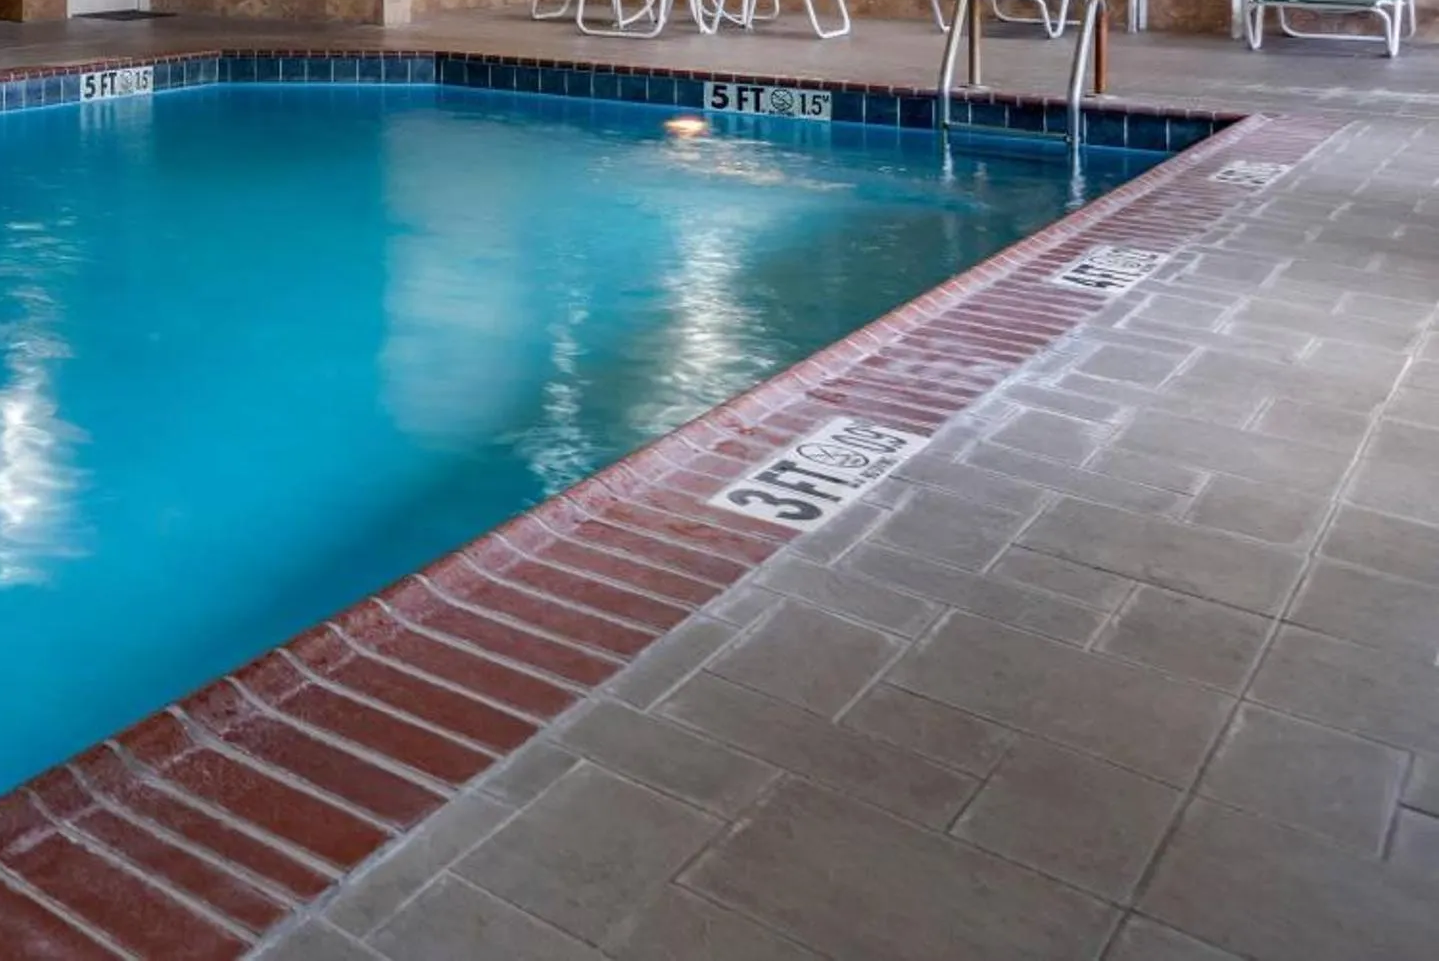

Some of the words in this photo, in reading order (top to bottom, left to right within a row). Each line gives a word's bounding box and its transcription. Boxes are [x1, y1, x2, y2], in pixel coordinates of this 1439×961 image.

[84, 74, 96, 99] 5
[711, 85, 729, 109] 5
[727, 489, 823, 521] 3
